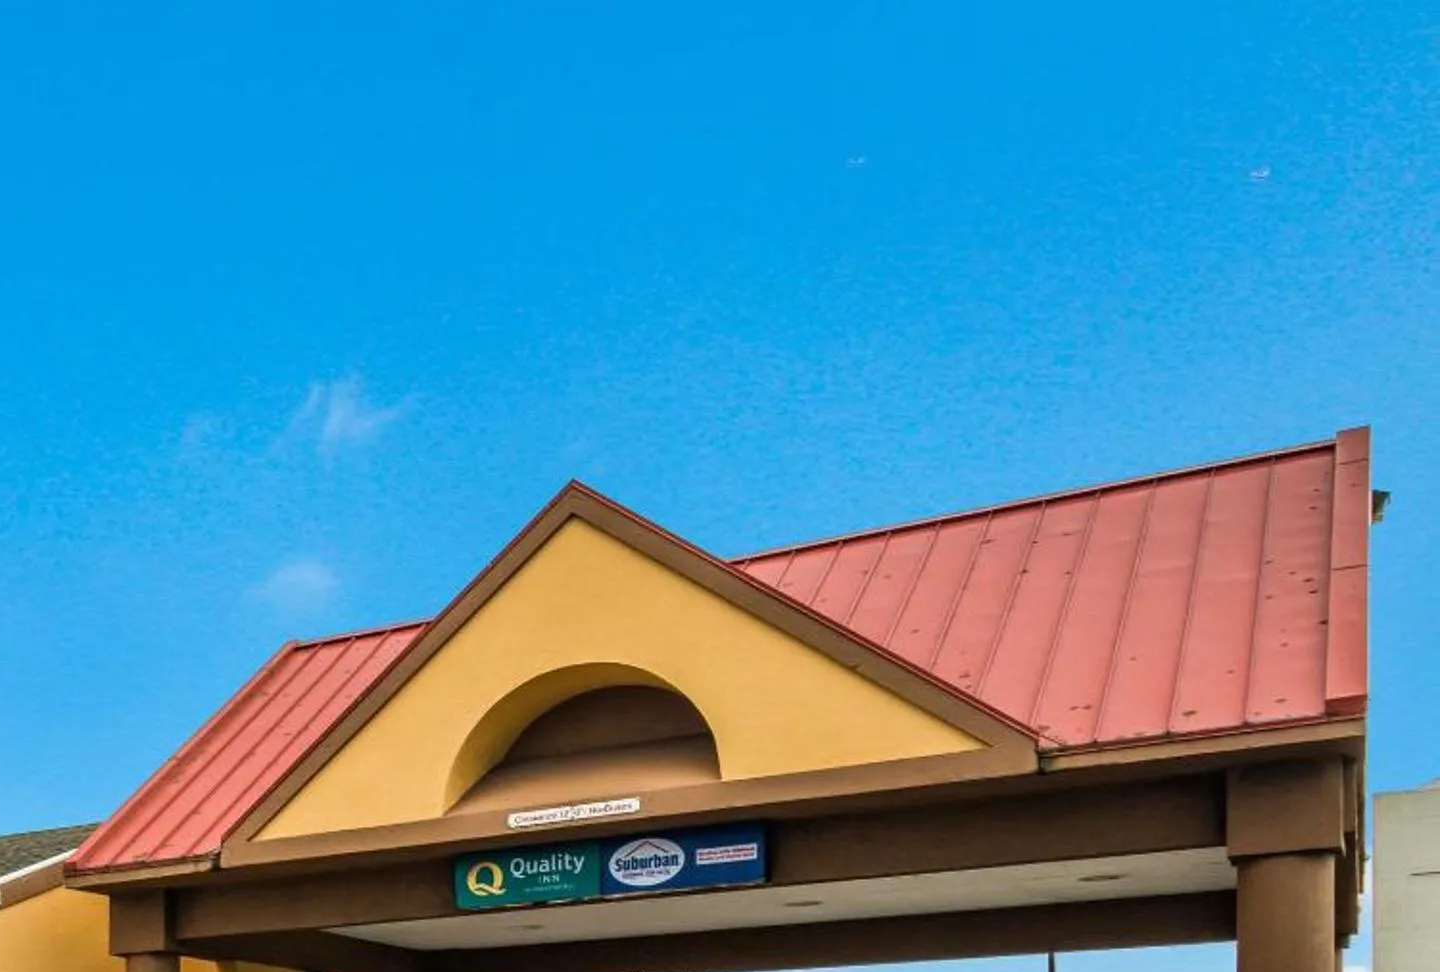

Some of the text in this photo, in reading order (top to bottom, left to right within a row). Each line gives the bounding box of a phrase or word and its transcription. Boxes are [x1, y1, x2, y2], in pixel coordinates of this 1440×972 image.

[510, 853, 585, 878] Quality
[615, 853, 679, 872] Suburban
[467, 862, 506, 896] Q
[538, 874, 560, 884] INN
